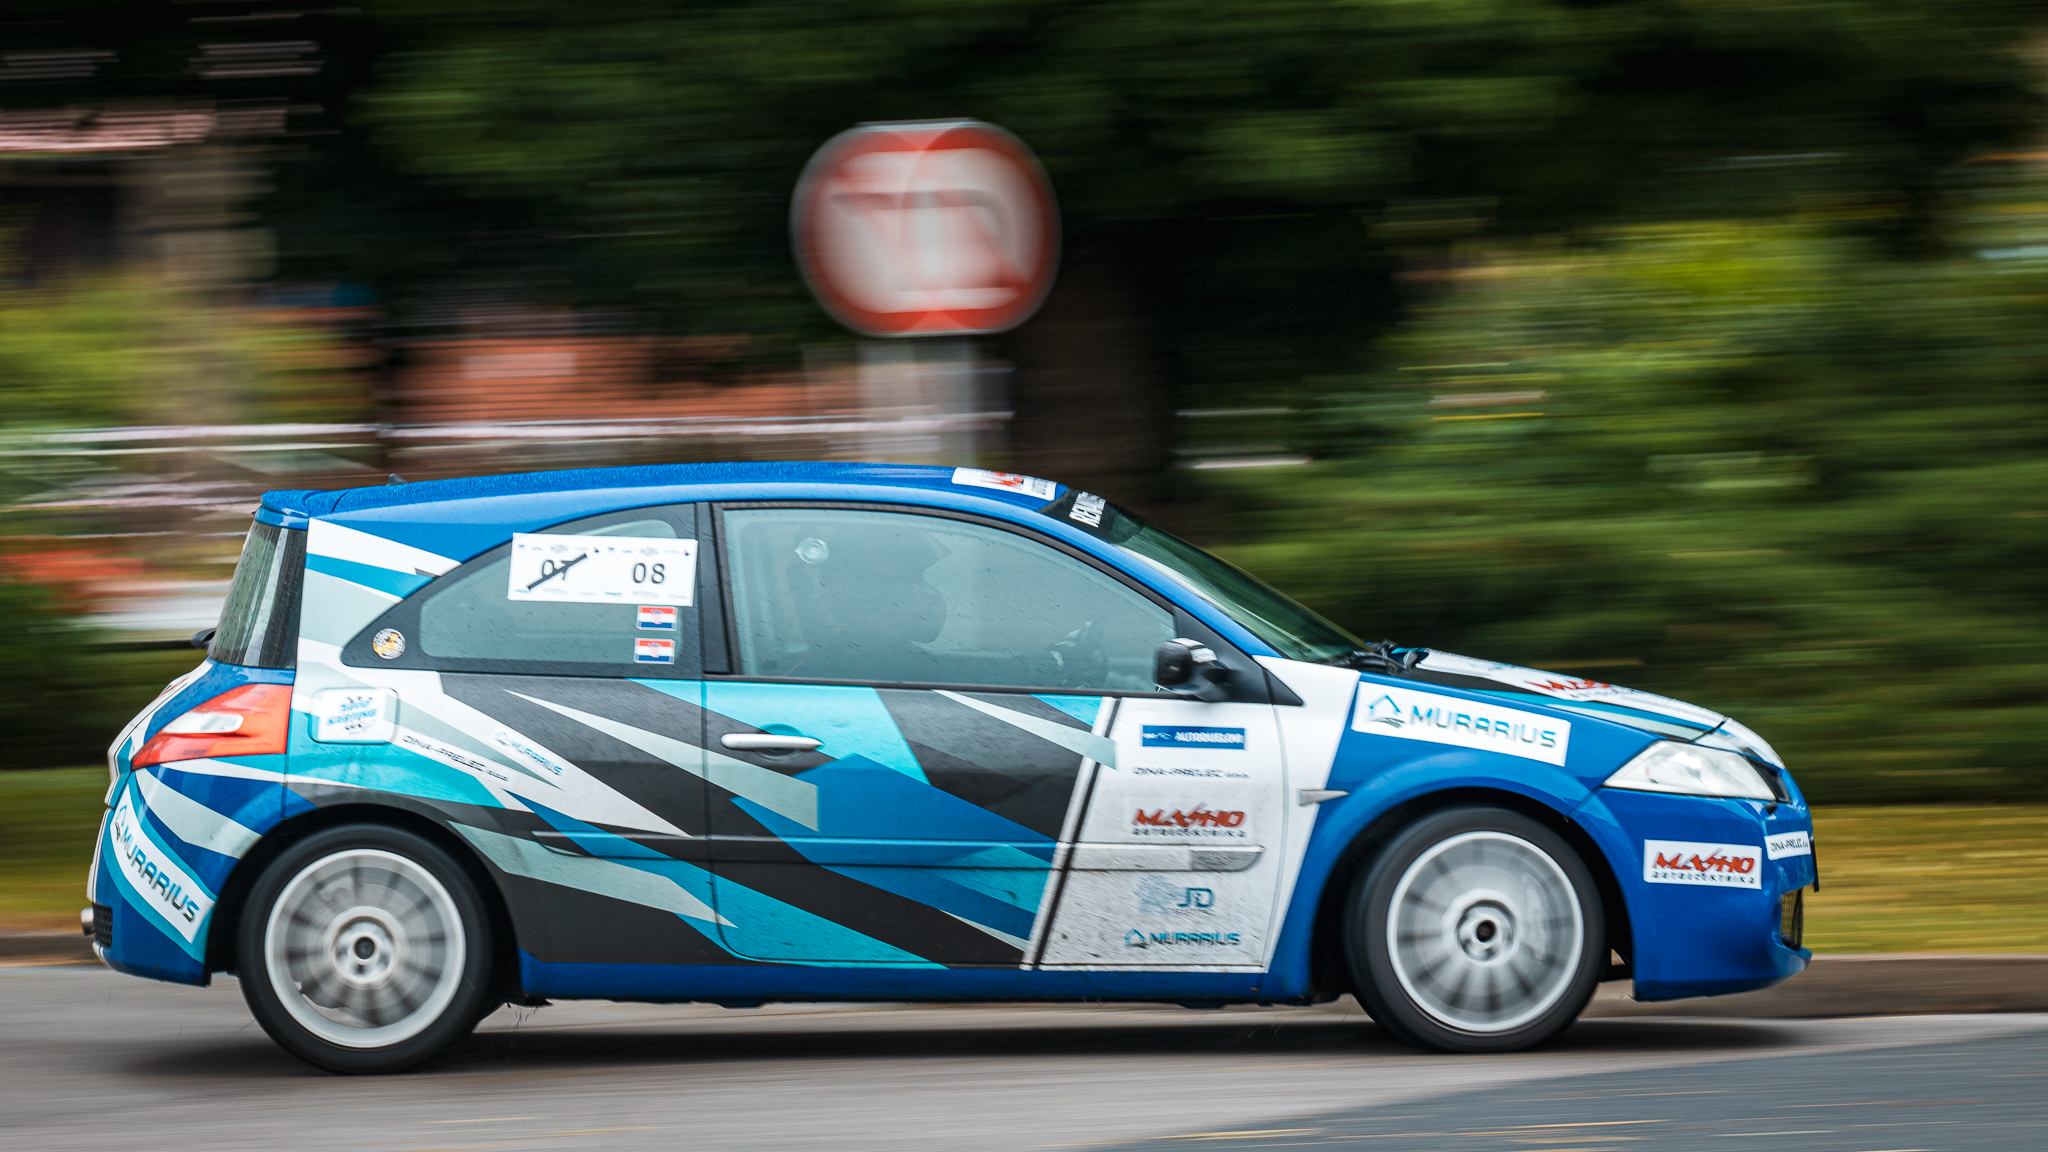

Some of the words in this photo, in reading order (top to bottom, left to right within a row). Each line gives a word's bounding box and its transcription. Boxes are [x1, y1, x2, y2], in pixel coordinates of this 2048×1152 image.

[633, 562, 665, 584] 08
[1411, 705, 1557, 749] MURARIUS
[120, 825, 200, 923] MURARIUS
[1177, 887, 1215, 909] JD
[1150, 931, 1241, 947] MURARIUS
